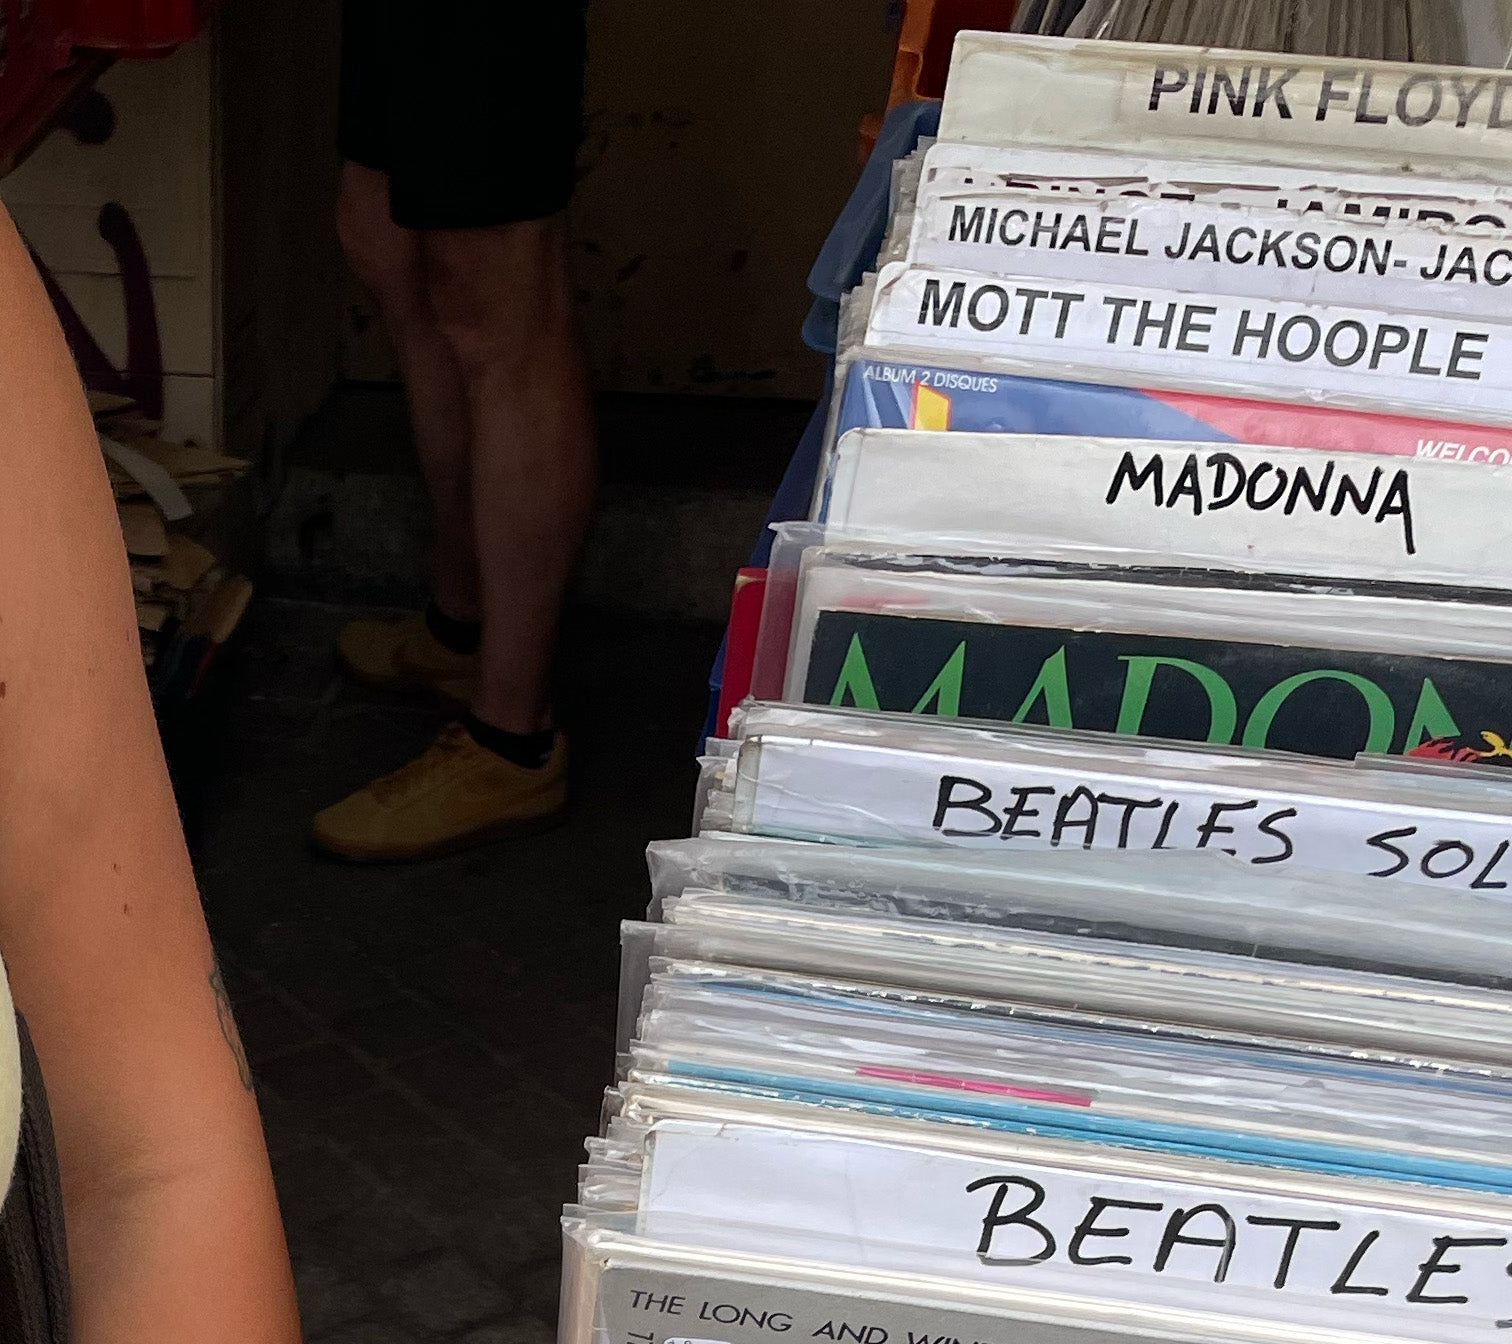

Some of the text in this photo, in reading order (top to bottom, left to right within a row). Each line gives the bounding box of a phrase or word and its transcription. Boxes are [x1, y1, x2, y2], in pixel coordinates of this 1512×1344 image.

[1147, 64, 1300, 120] PINK
[948, 205, 1149, 256] MICHAEL
[917, 279, 1490, 380] MOTT THE HOOPLE
[863, 365, 999, 393] ALBUM 2 DISQUES
[1106, 451, 1416, 555] MADONNA
[932, 775, 1297, 864] BEATLES
[630, 1289, 686, 1317] THE
[699, 1301, 793, 1332] LONG
